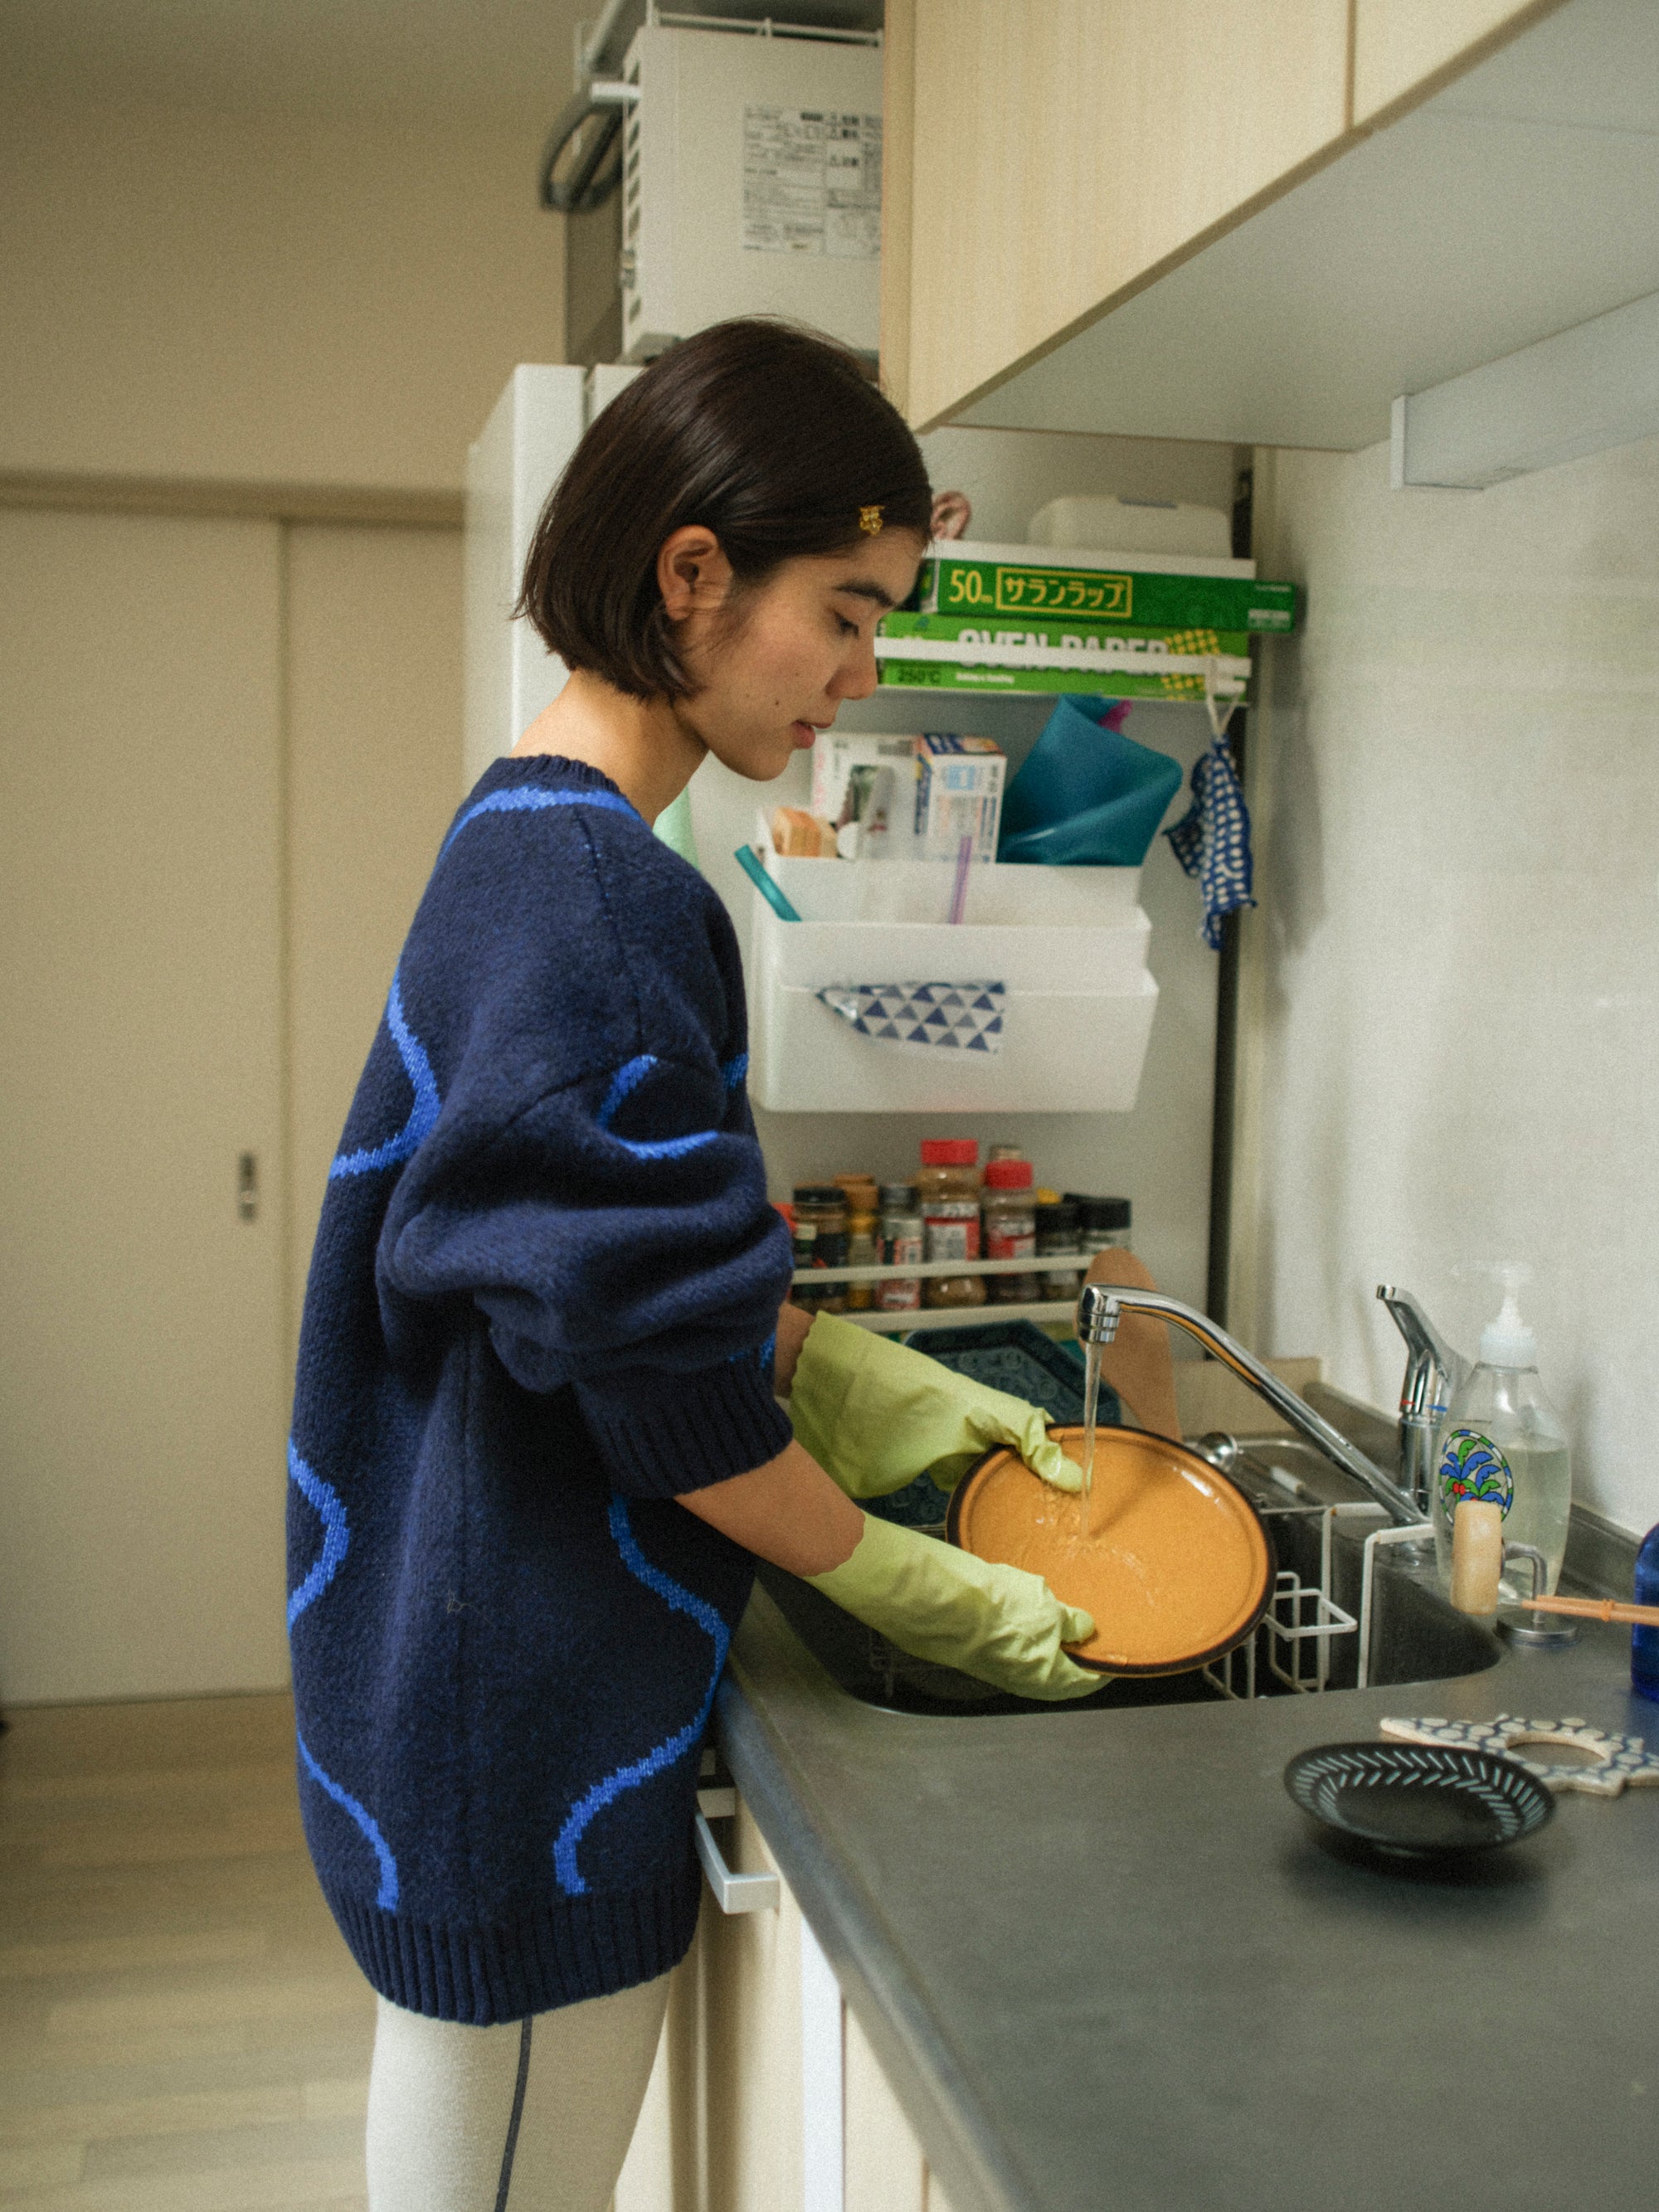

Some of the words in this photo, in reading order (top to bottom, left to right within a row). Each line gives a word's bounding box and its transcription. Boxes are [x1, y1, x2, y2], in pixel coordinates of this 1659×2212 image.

[1005, 577, 1125, 609] サランラップ
